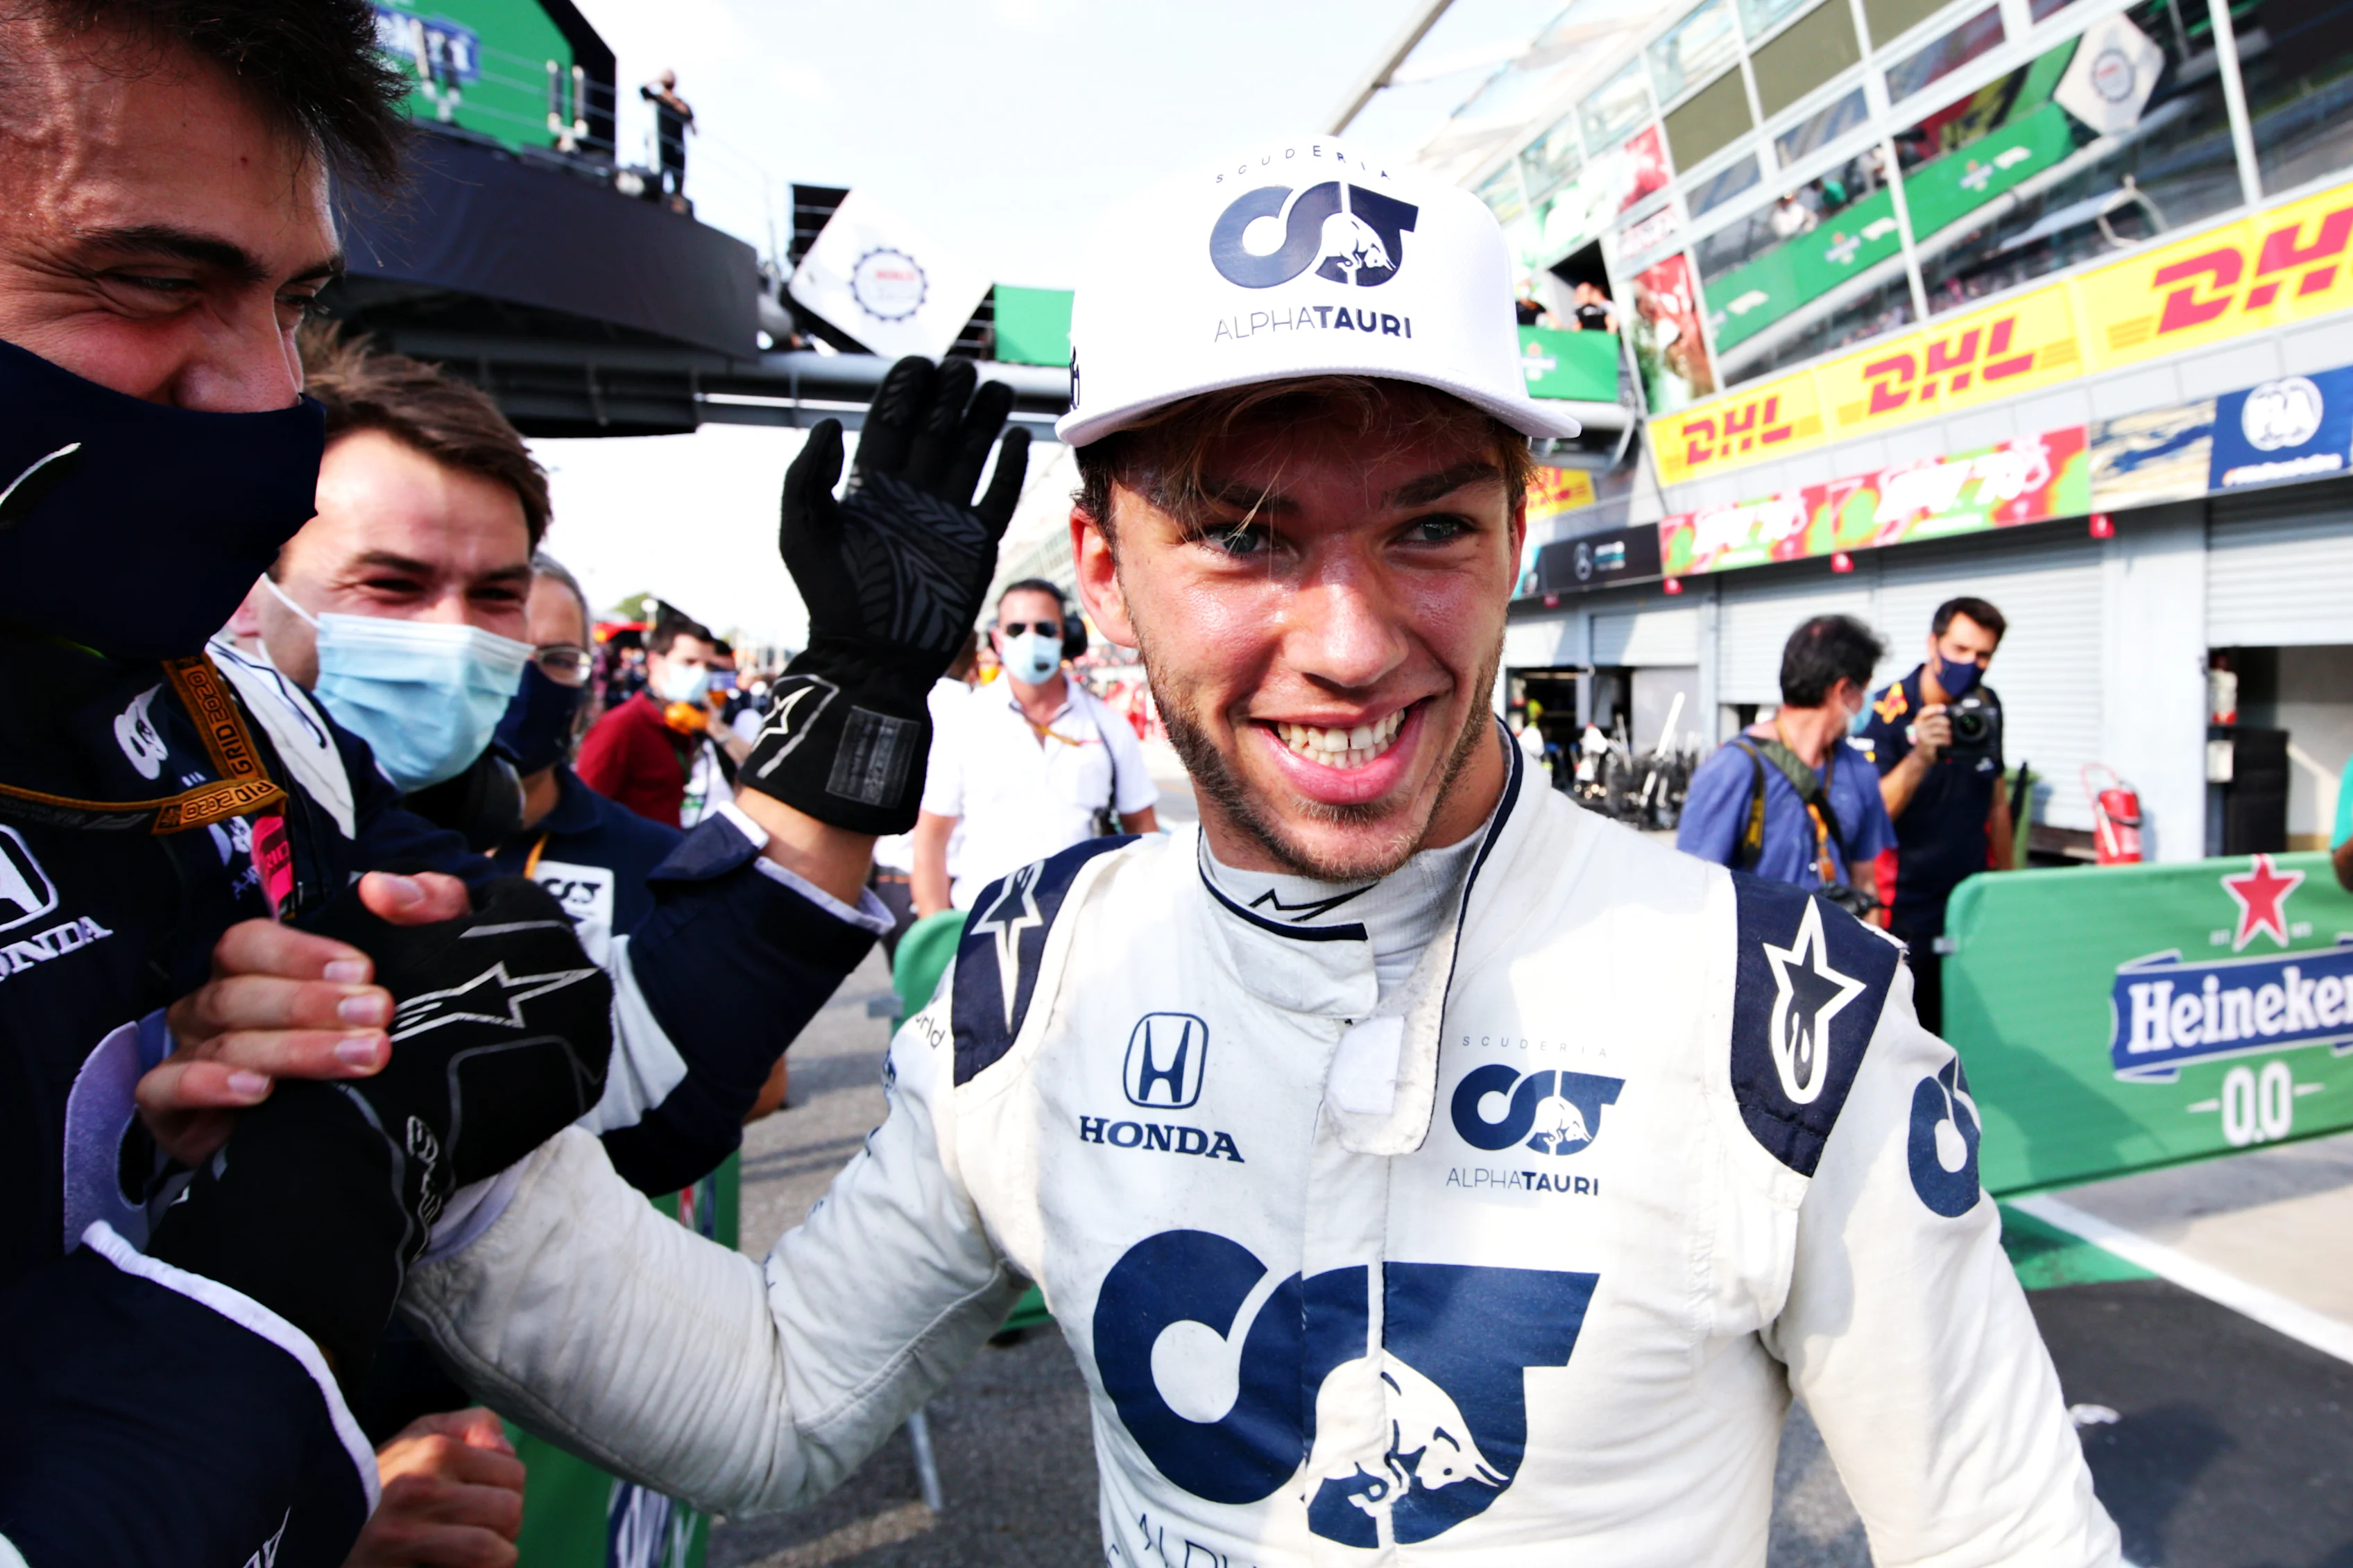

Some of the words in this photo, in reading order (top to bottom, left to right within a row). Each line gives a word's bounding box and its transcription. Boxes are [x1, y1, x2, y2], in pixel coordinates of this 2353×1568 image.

[1215, 145, 1390, 183] SCUDERIA
[2152, 206, 2353, 336] DH
[1214, 305, 1412, 343] ALPHATAURI
[1863, 317, 2035, 416] DHL
[1682, 396, 1792, 465] DHL
[187, 670, 230, 724] 2020
[216, 723, 253, 775] GRID
[181, 790, 234, 820] 2020
[234, 783, 275, 802] RID
[1462, 1036, 1607, 1058] SCUDERIA
[1079, 1115, 1245, 1164] HONDA
[1446, 1168, 1599, 1196] ALPHATAURI
